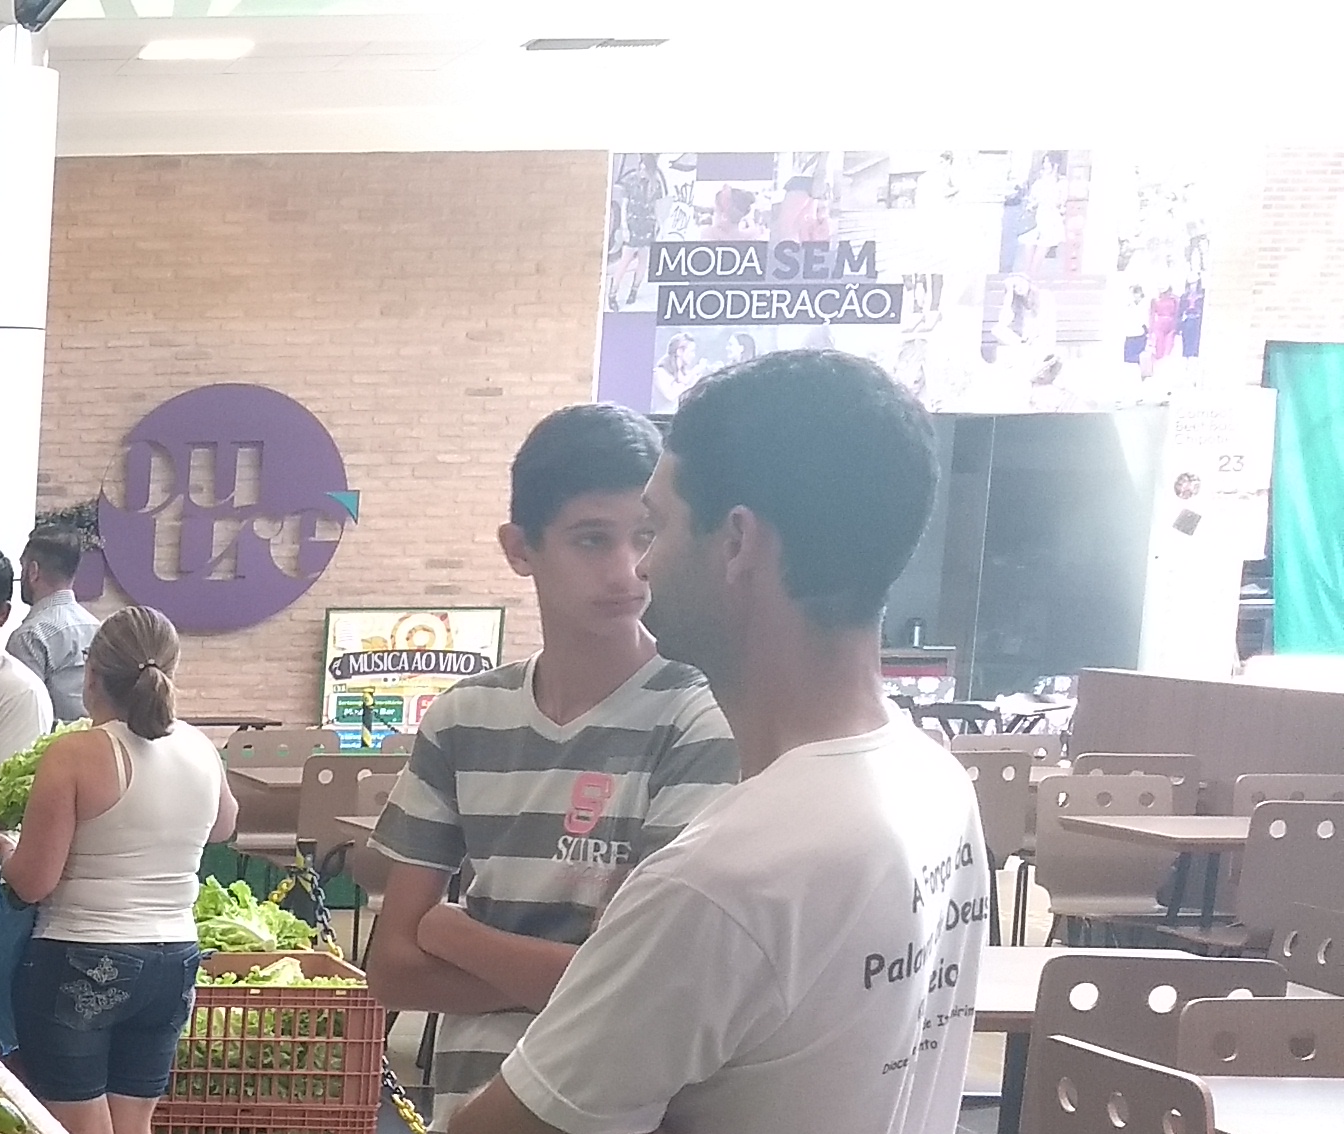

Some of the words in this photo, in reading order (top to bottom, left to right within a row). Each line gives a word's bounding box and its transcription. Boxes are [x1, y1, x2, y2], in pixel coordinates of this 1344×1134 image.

[655, 245, 764, 277] MODA
[771, 239, 879, 280] SEM
[663, 282, 896, 325] MODERAÇÃO.
[1218, 454, 1245, 472] 23
[349, 650, 409, 674] MÚSICA
[411, 651, 436, 672] AO
[439, 652, 475, 673] VIVO
[551, 834, 632, 869] SURF
[912, 877, 925, 914] A
